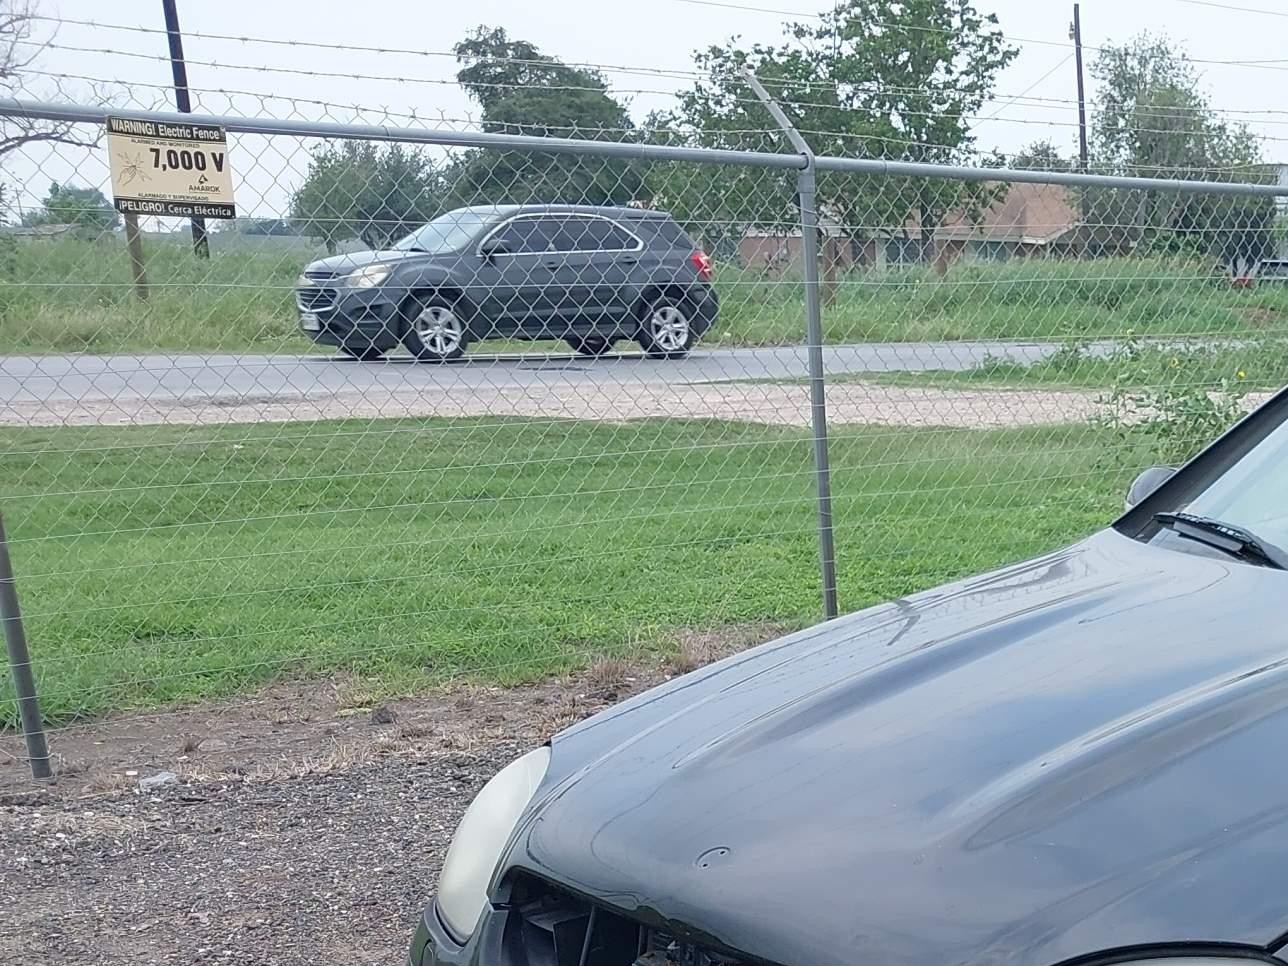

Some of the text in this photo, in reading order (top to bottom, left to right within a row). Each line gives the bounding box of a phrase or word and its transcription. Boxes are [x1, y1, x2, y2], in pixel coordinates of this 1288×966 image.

[111, 118, 220, 140] WARNING! Electric Fence
[149, 148, 224, 172] 7,000 V
[189, 184, 220, 192] AMAROK
[119, 200, 231, 216] ¡PELIGRO! Cerca Eléctrica
